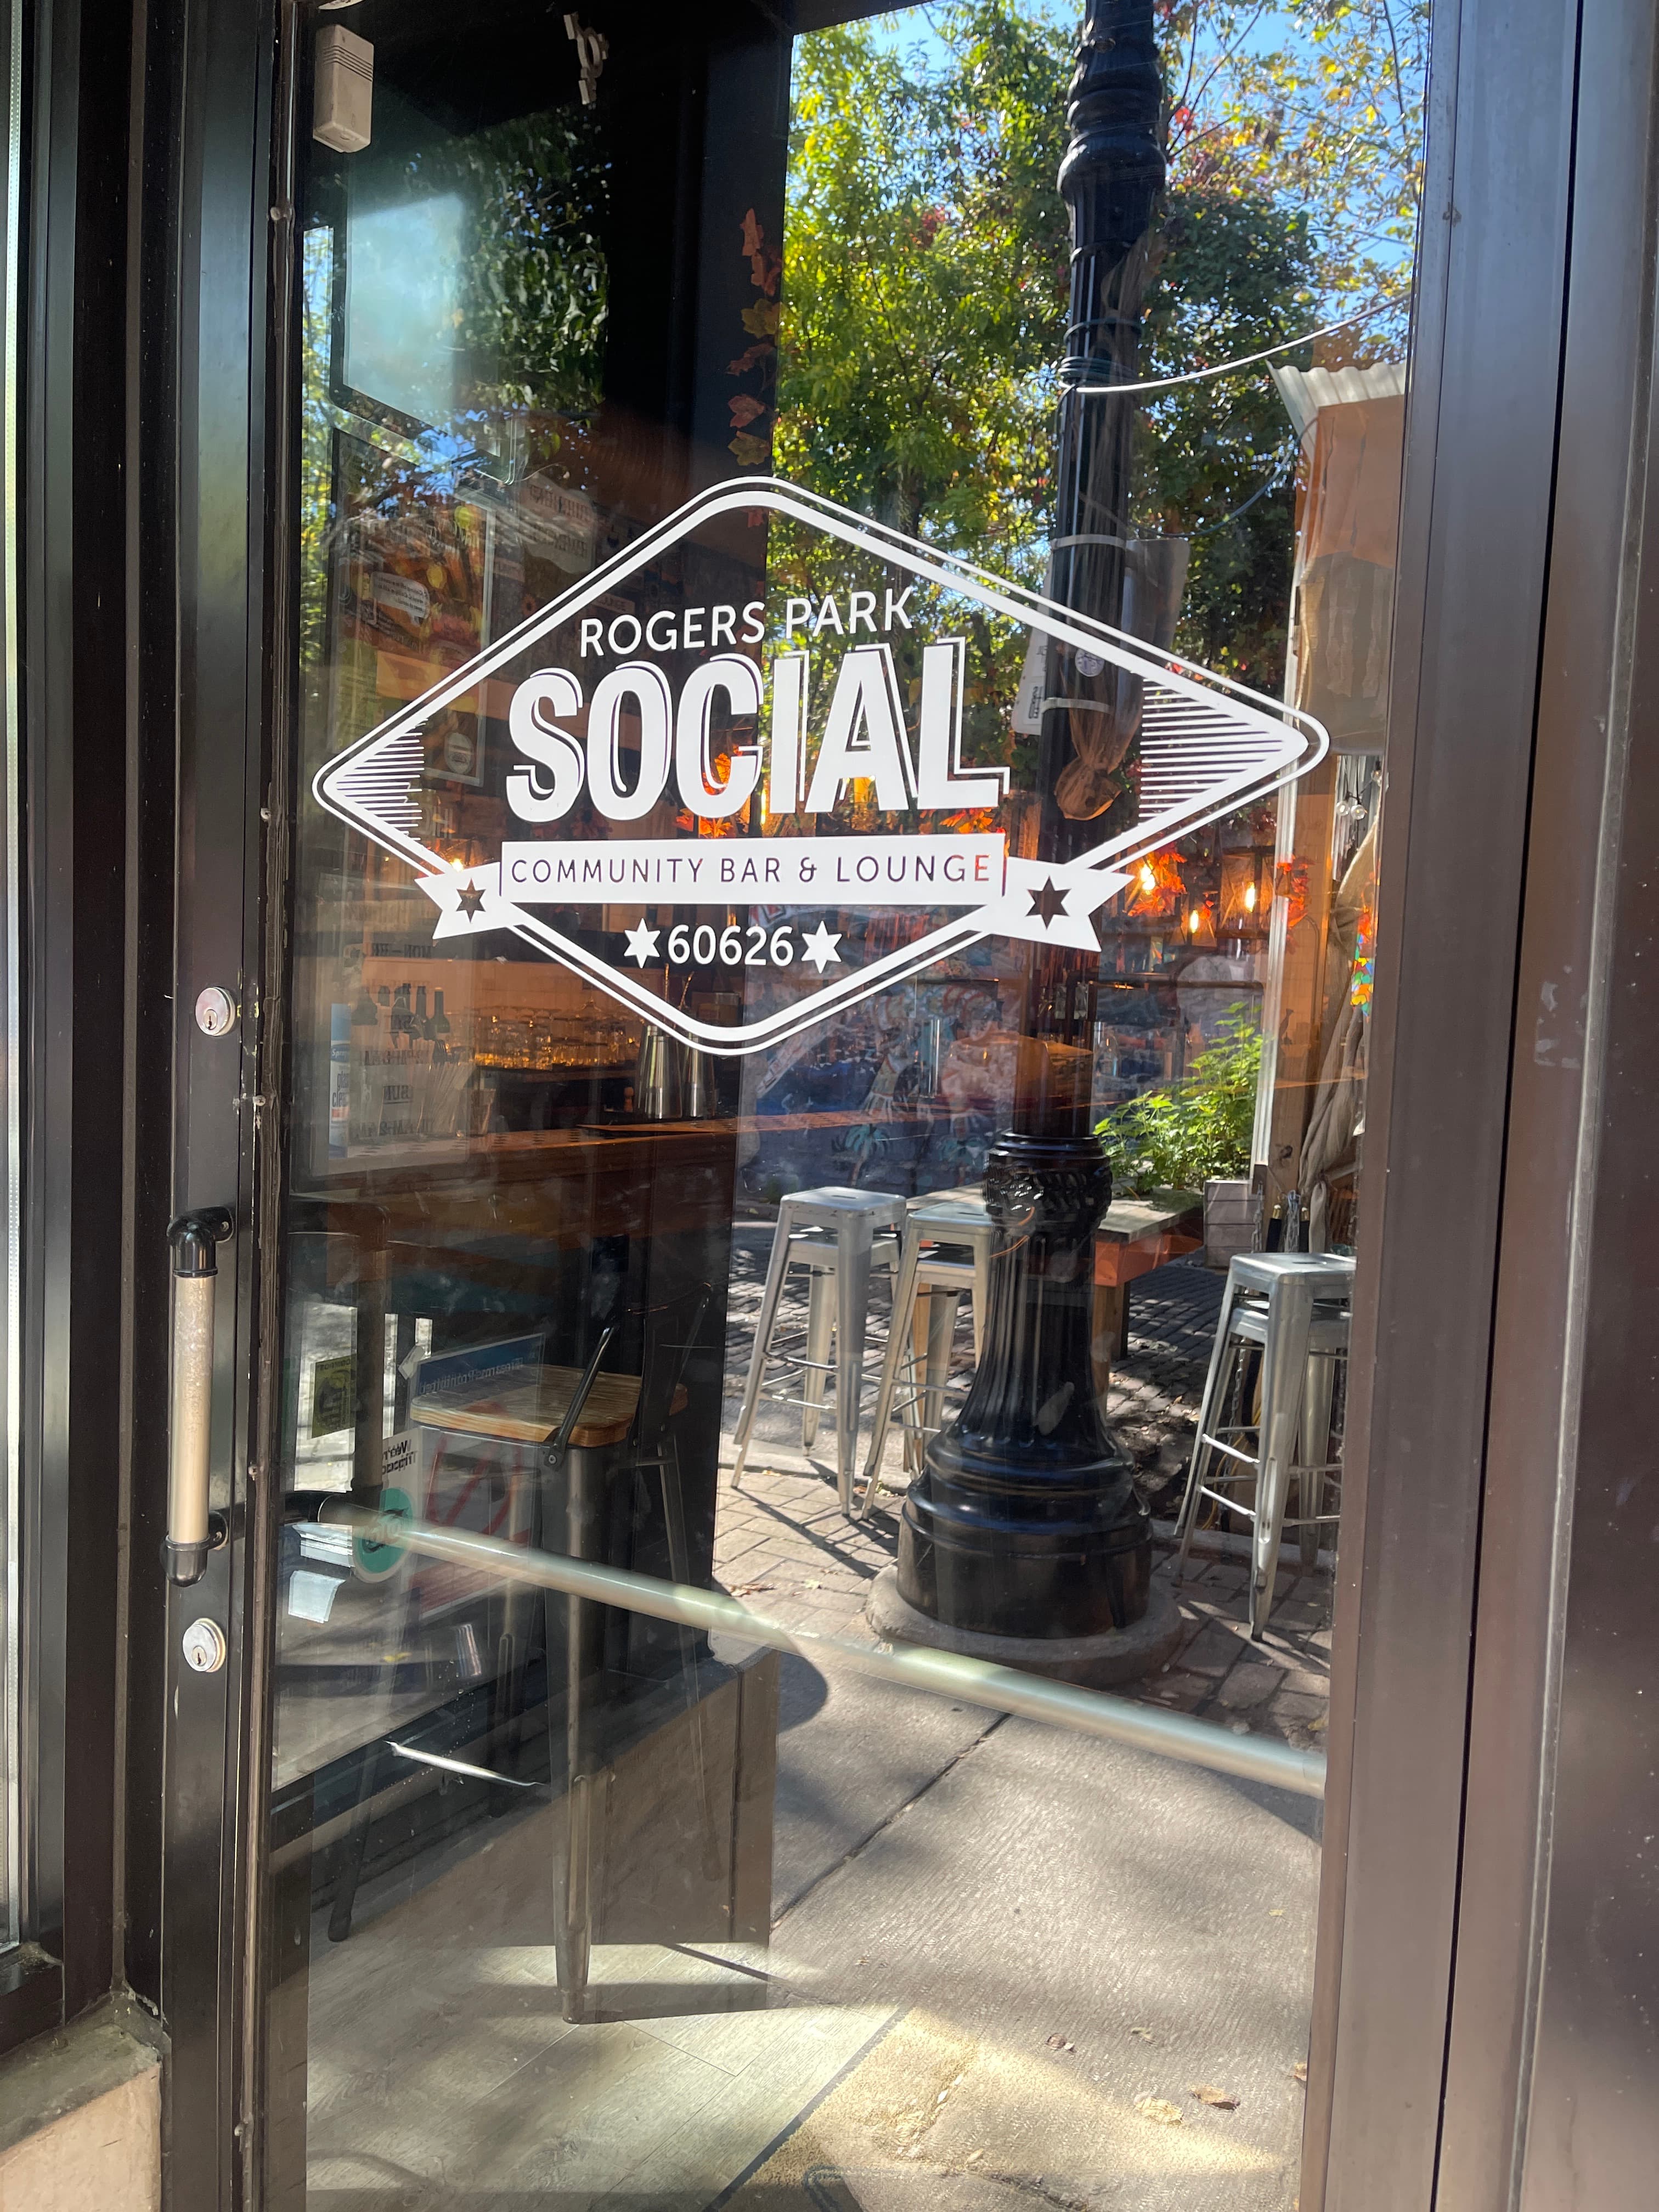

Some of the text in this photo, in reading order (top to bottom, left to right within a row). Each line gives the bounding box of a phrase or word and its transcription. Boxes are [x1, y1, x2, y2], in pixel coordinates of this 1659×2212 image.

[580, 587, 913, 658] ROGERS PARK
[506, 636, 1012, 822] SOCIAL
[511, 853, 991, 885] COMMUNITY BAR & LOUNGE
[667, 924, 794, 967] 60626
